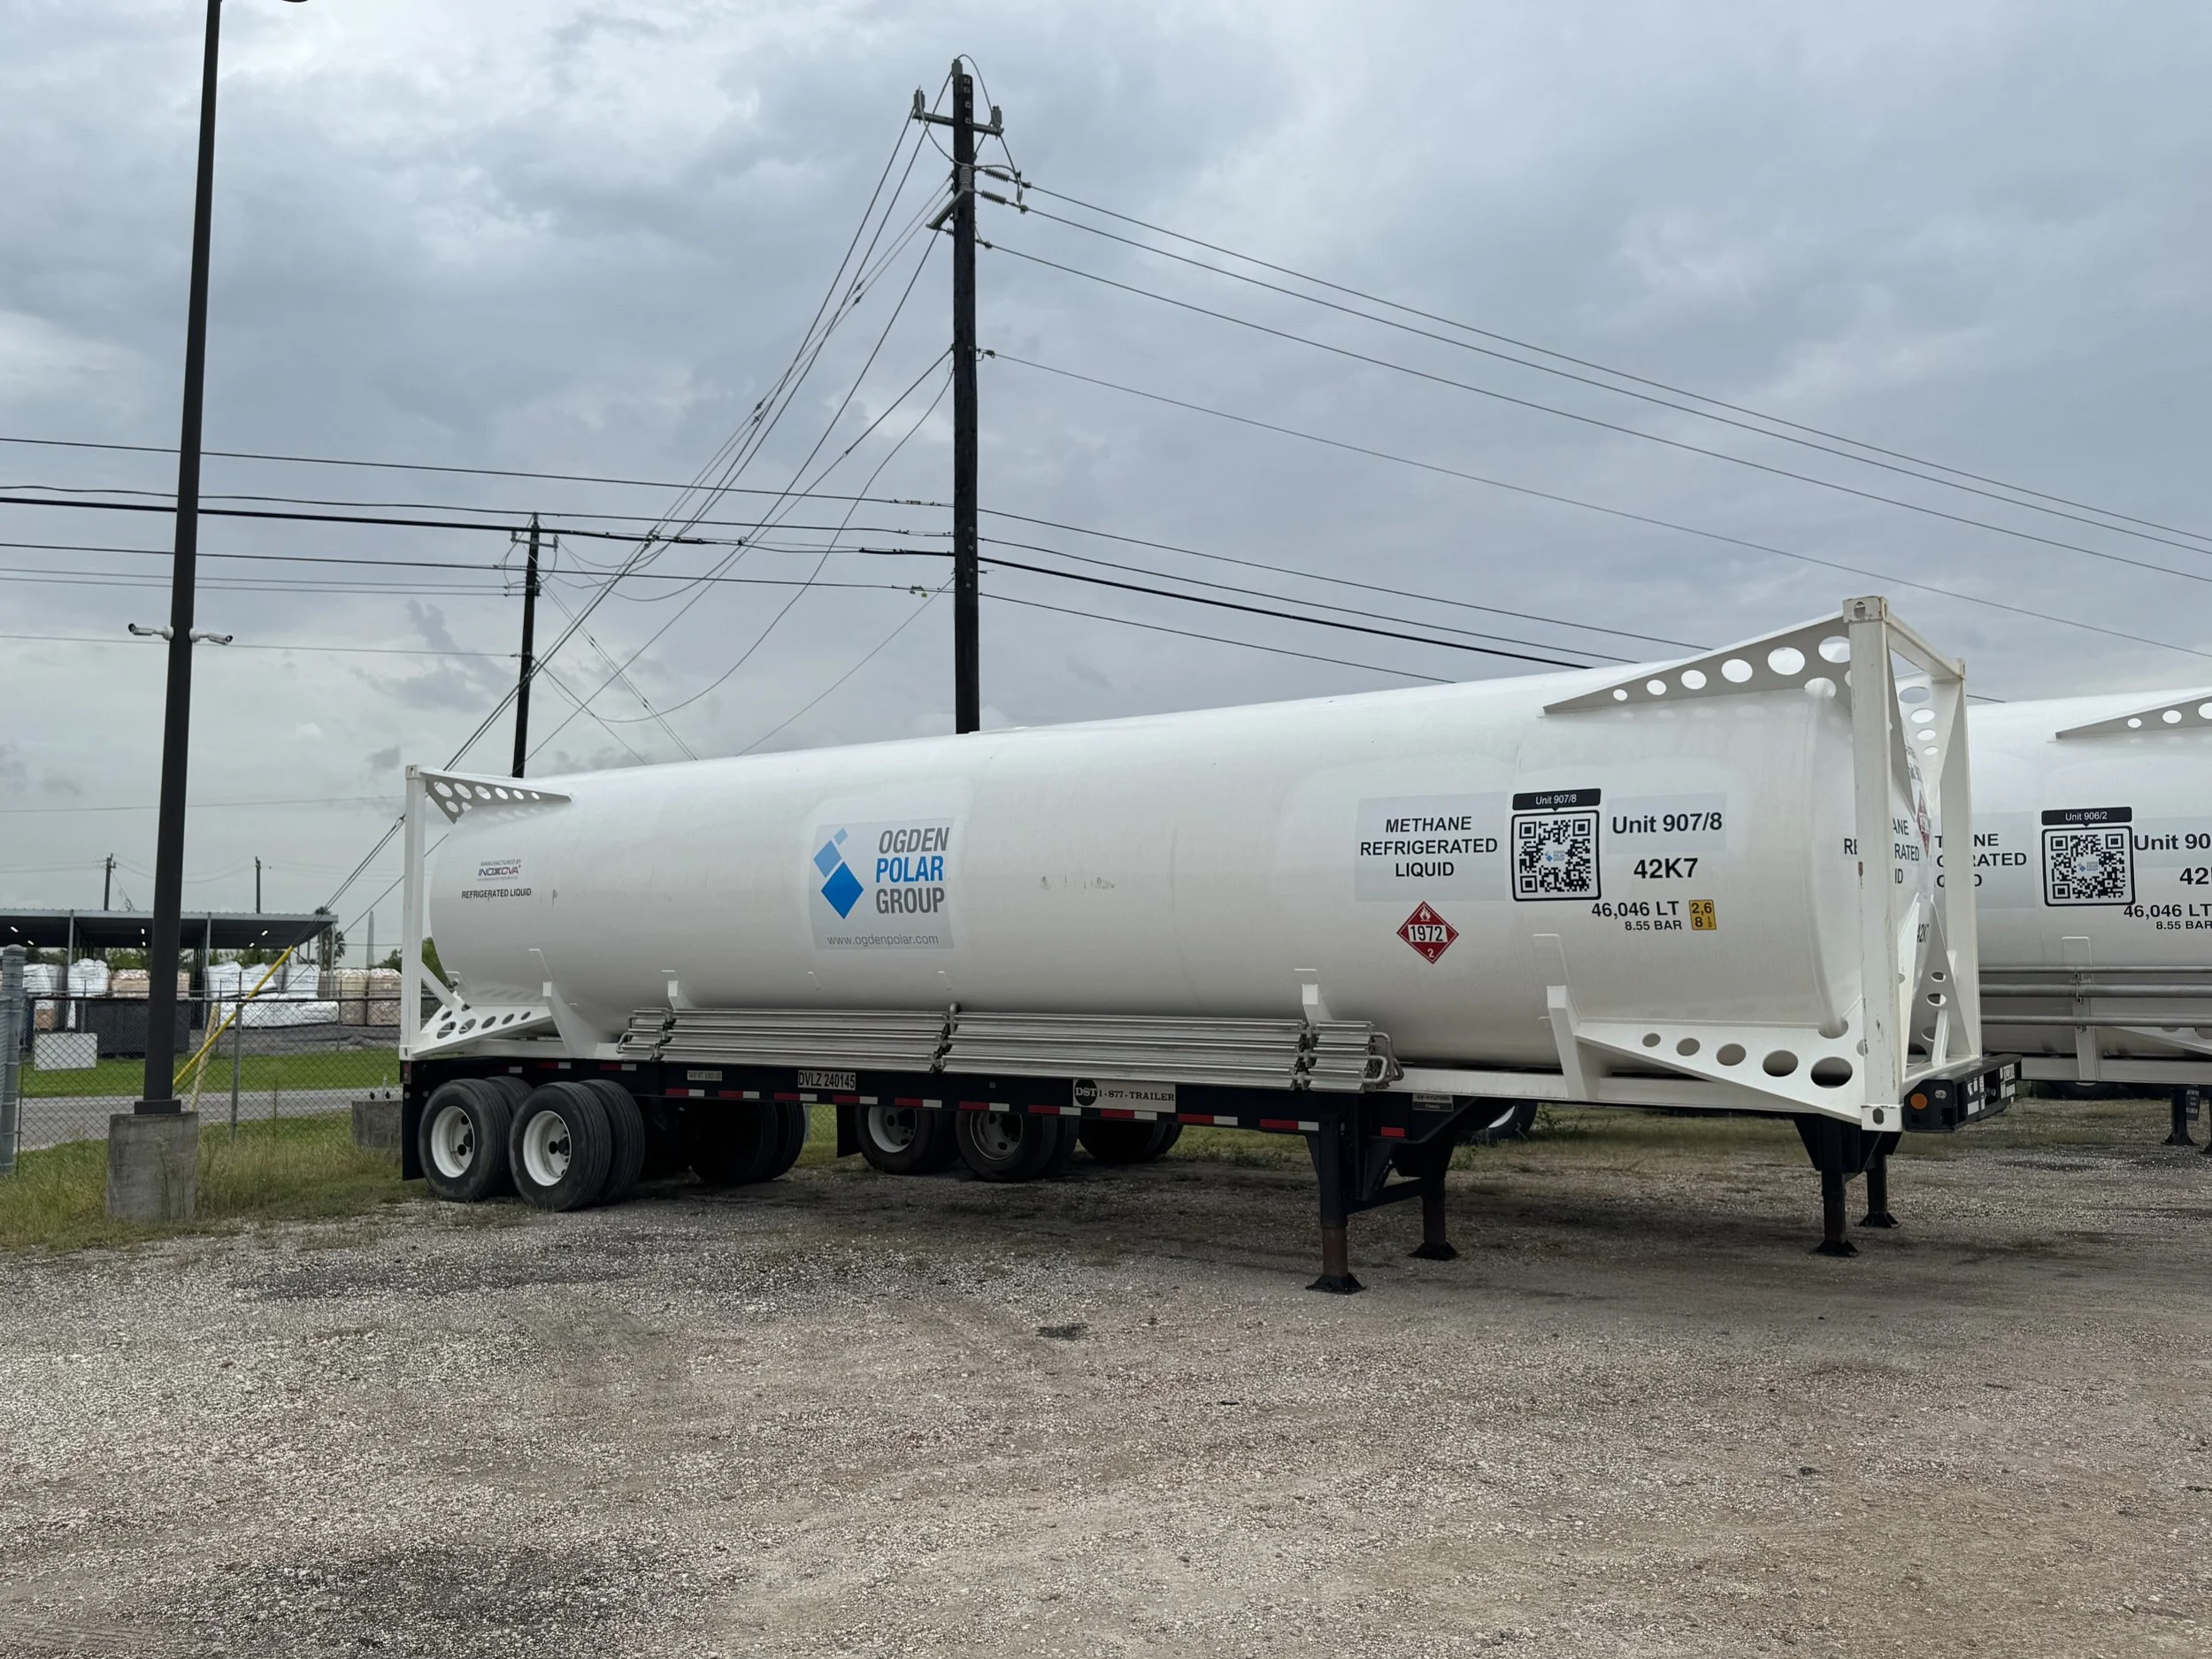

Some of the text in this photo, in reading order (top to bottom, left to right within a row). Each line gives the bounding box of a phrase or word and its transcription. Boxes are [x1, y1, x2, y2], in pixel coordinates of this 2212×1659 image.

[1535, 794, 1578, 805] Unit 907/8
[1386, 816, 1471, 833] METHANE
[1612, 811, 1723, 834] Unit 907/8
[2065, 811, 2108, 821] Unit 906/2
[879, 827, 949, 854] OGDEN
[1360, 838, 1498, 856] REFRIGERATED
[2133, 833, 2212, 851] Unit 90
[875, 855, 944, 884] POLAR
[1395, 862, 1455, 878] LIQUID
[1633, 857, 1699, 879] 42K7
[2179, 867, 2212, 886] 42
[461, 887, 532, 900] REFRIGERATED LIQUID
[875, 887, 945, 915] GROUP
[1591, 901, 1680, 919] 46,046 LT
[1691, 902, 1713, 917] 2,6
[2123, 903, 2212, 919] 46,046 LT
[1409, 925, 1444, 942] 1972
[1624, 919, 1683, 931] 8.55 BAR
[2155, 920, 2182, 930] 8.55
[826, 933, 940, 949] www.ogdenpolar.com
[1427, 948, 1435, 958] 2
[798, 1071, 855, 1089] DVLZ 240145
[1075, 1087, 1097, 1097] DST
